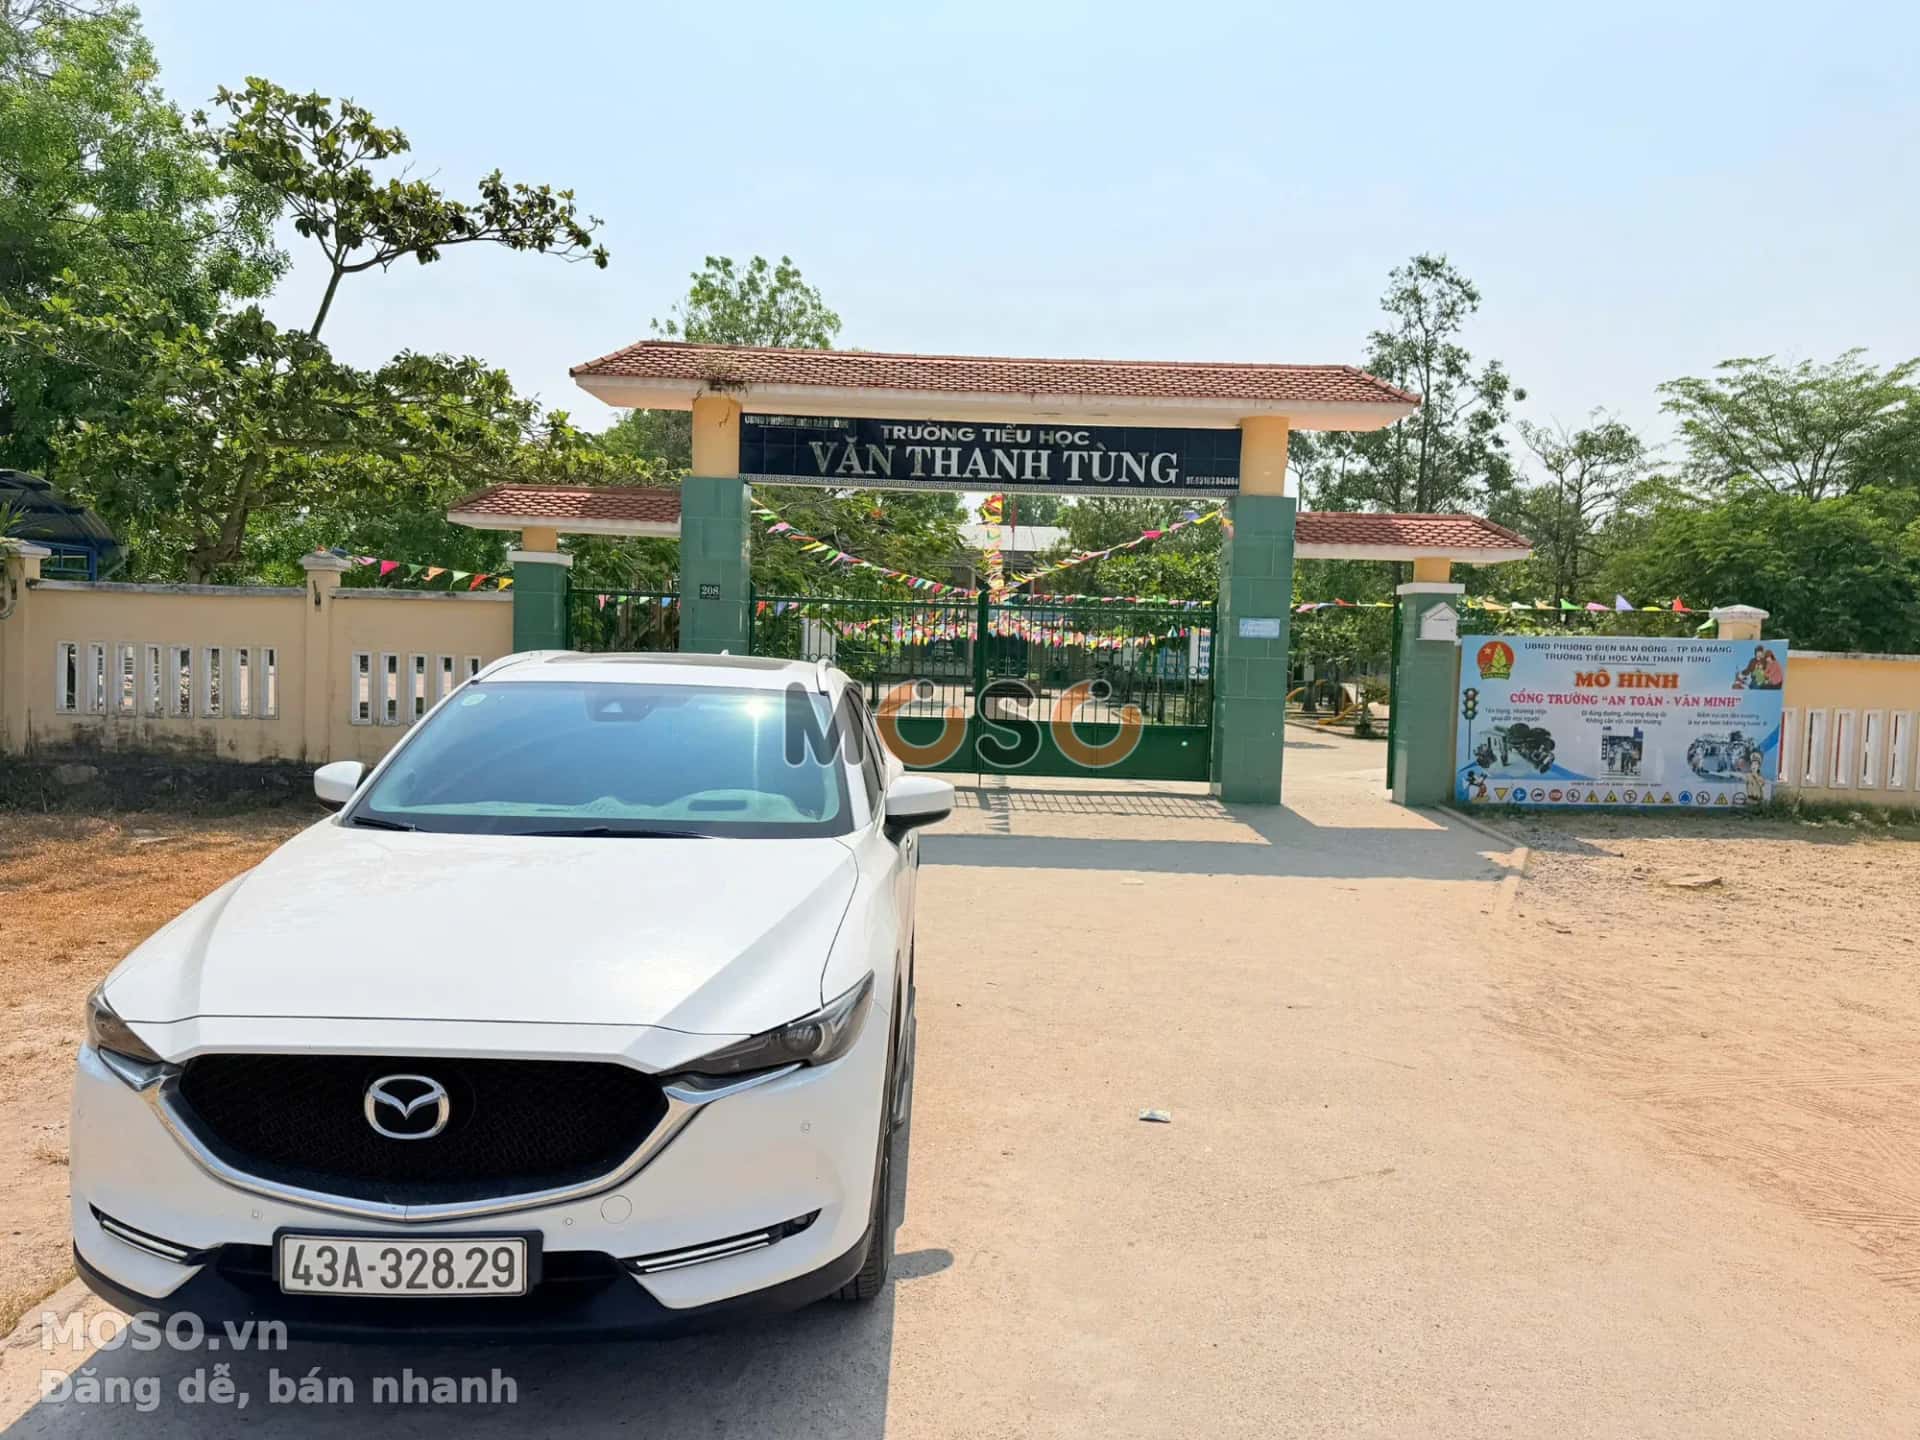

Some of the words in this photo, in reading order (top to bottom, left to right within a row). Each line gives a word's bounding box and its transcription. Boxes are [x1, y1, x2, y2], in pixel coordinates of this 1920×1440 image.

[880, 419, 977, 442] TRƯỜNG
[982, 423, 1032, 444] TIỂU
[1039, 429, 1091, 448] HỌC
[808, 435, 897, 476] VĂN
[905, 445, 1052, 481] THANH
[1062, 441, 1179, 484] TÙNG
[701, 585, 719, 595] 208
[1524, 642, 1551, 650] UBND
[1653, 655, 1683, 663] THANH
[1574, 668, 1610, 688] MÔ
[1617, 669, 1680, 690] HÌNH
[1510, 688, 1544, 704] CỔNG
[1547, 692, 1598, 706] TRƯỜNG
[1630, 693, 1663, 707] TOÀN
[1674, 694, 1700, 707] VĂN
[291, 1245, 517, 1290] 43A-328.29
